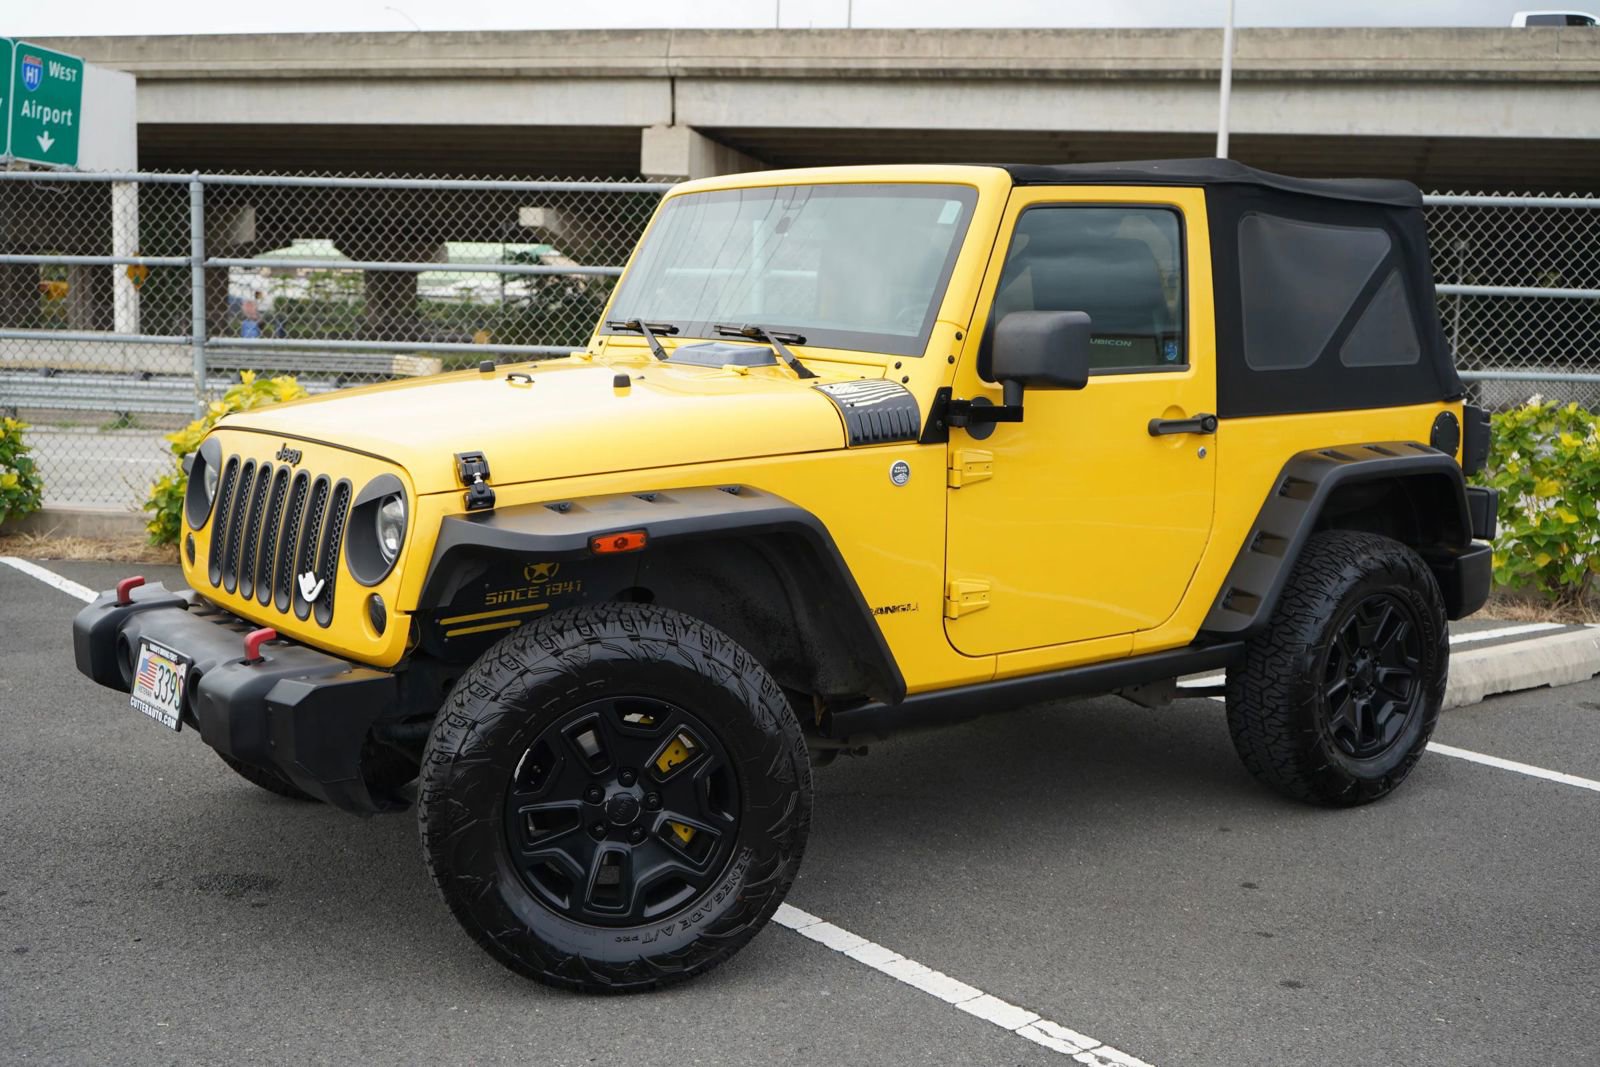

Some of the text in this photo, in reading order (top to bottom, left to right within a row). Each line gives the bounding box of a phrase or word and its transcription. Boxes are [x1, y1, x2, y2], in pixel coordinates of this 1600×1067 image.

[26, 60, 77, 85] H1 WEST
[21, 99, 73, 126] Airport
[1089, 338, 1132, 347] UBICON
[276, 442, 303, 468] Jeep
[545, 580, 582, 596] 1941
[130, 697, 177, 730] CUTTERAUTO.COM
[678, 846, 753, 932] RENEGADE
[641, 924, 676, 945] A/T
